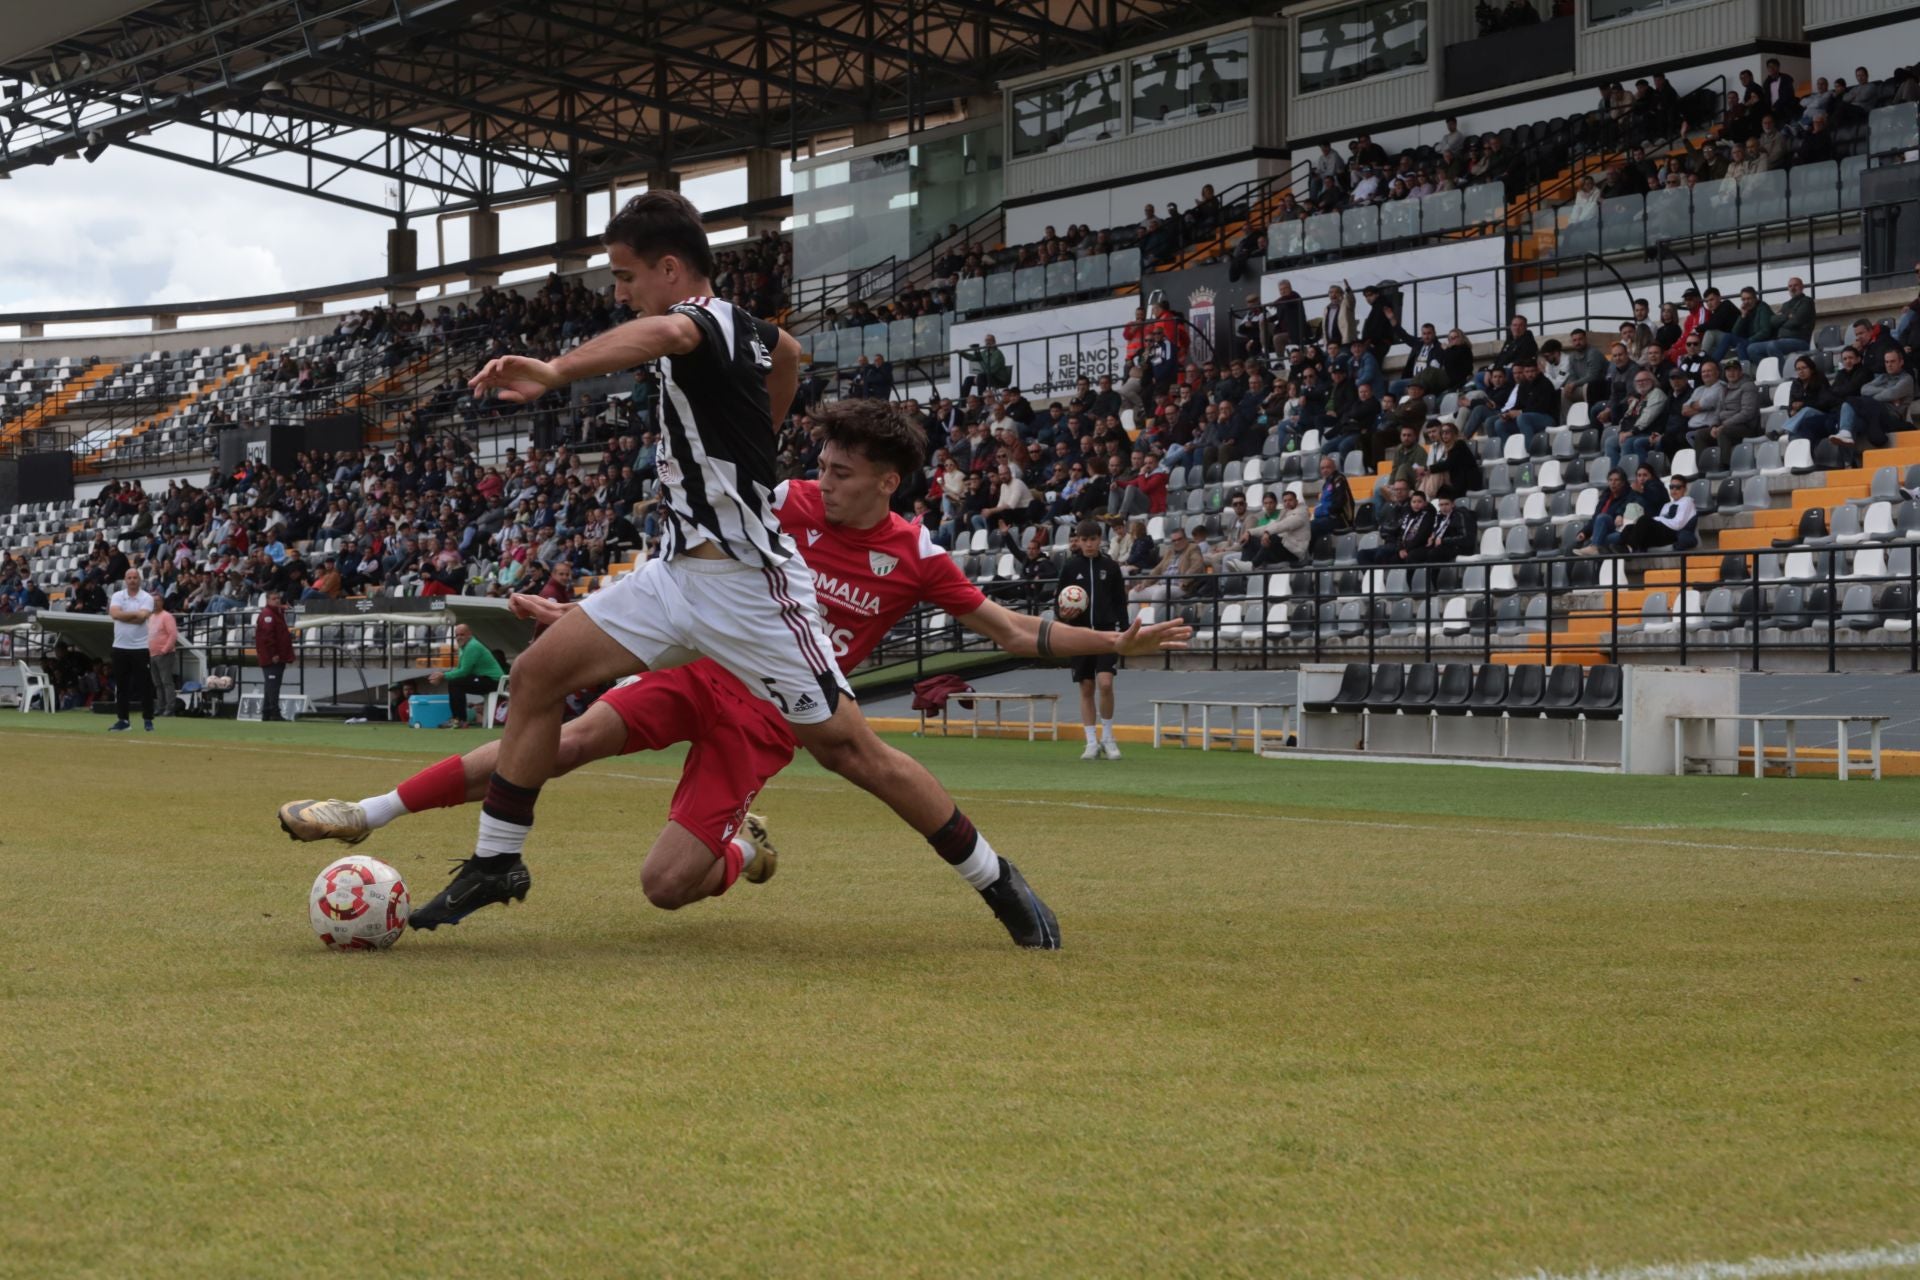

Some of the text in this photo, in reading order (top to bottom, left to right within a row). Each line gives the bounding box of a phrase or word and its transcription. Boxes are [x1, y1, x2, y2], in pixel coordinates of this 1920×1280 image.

[1059, 347, 1119, 367] BLANCO
[1058, 363, 1106, 380] NEGRO
[248, 447, 264, 461] HOY
[759, 677, 789, 714] 5
[792, 702, 818, 712] adidas
